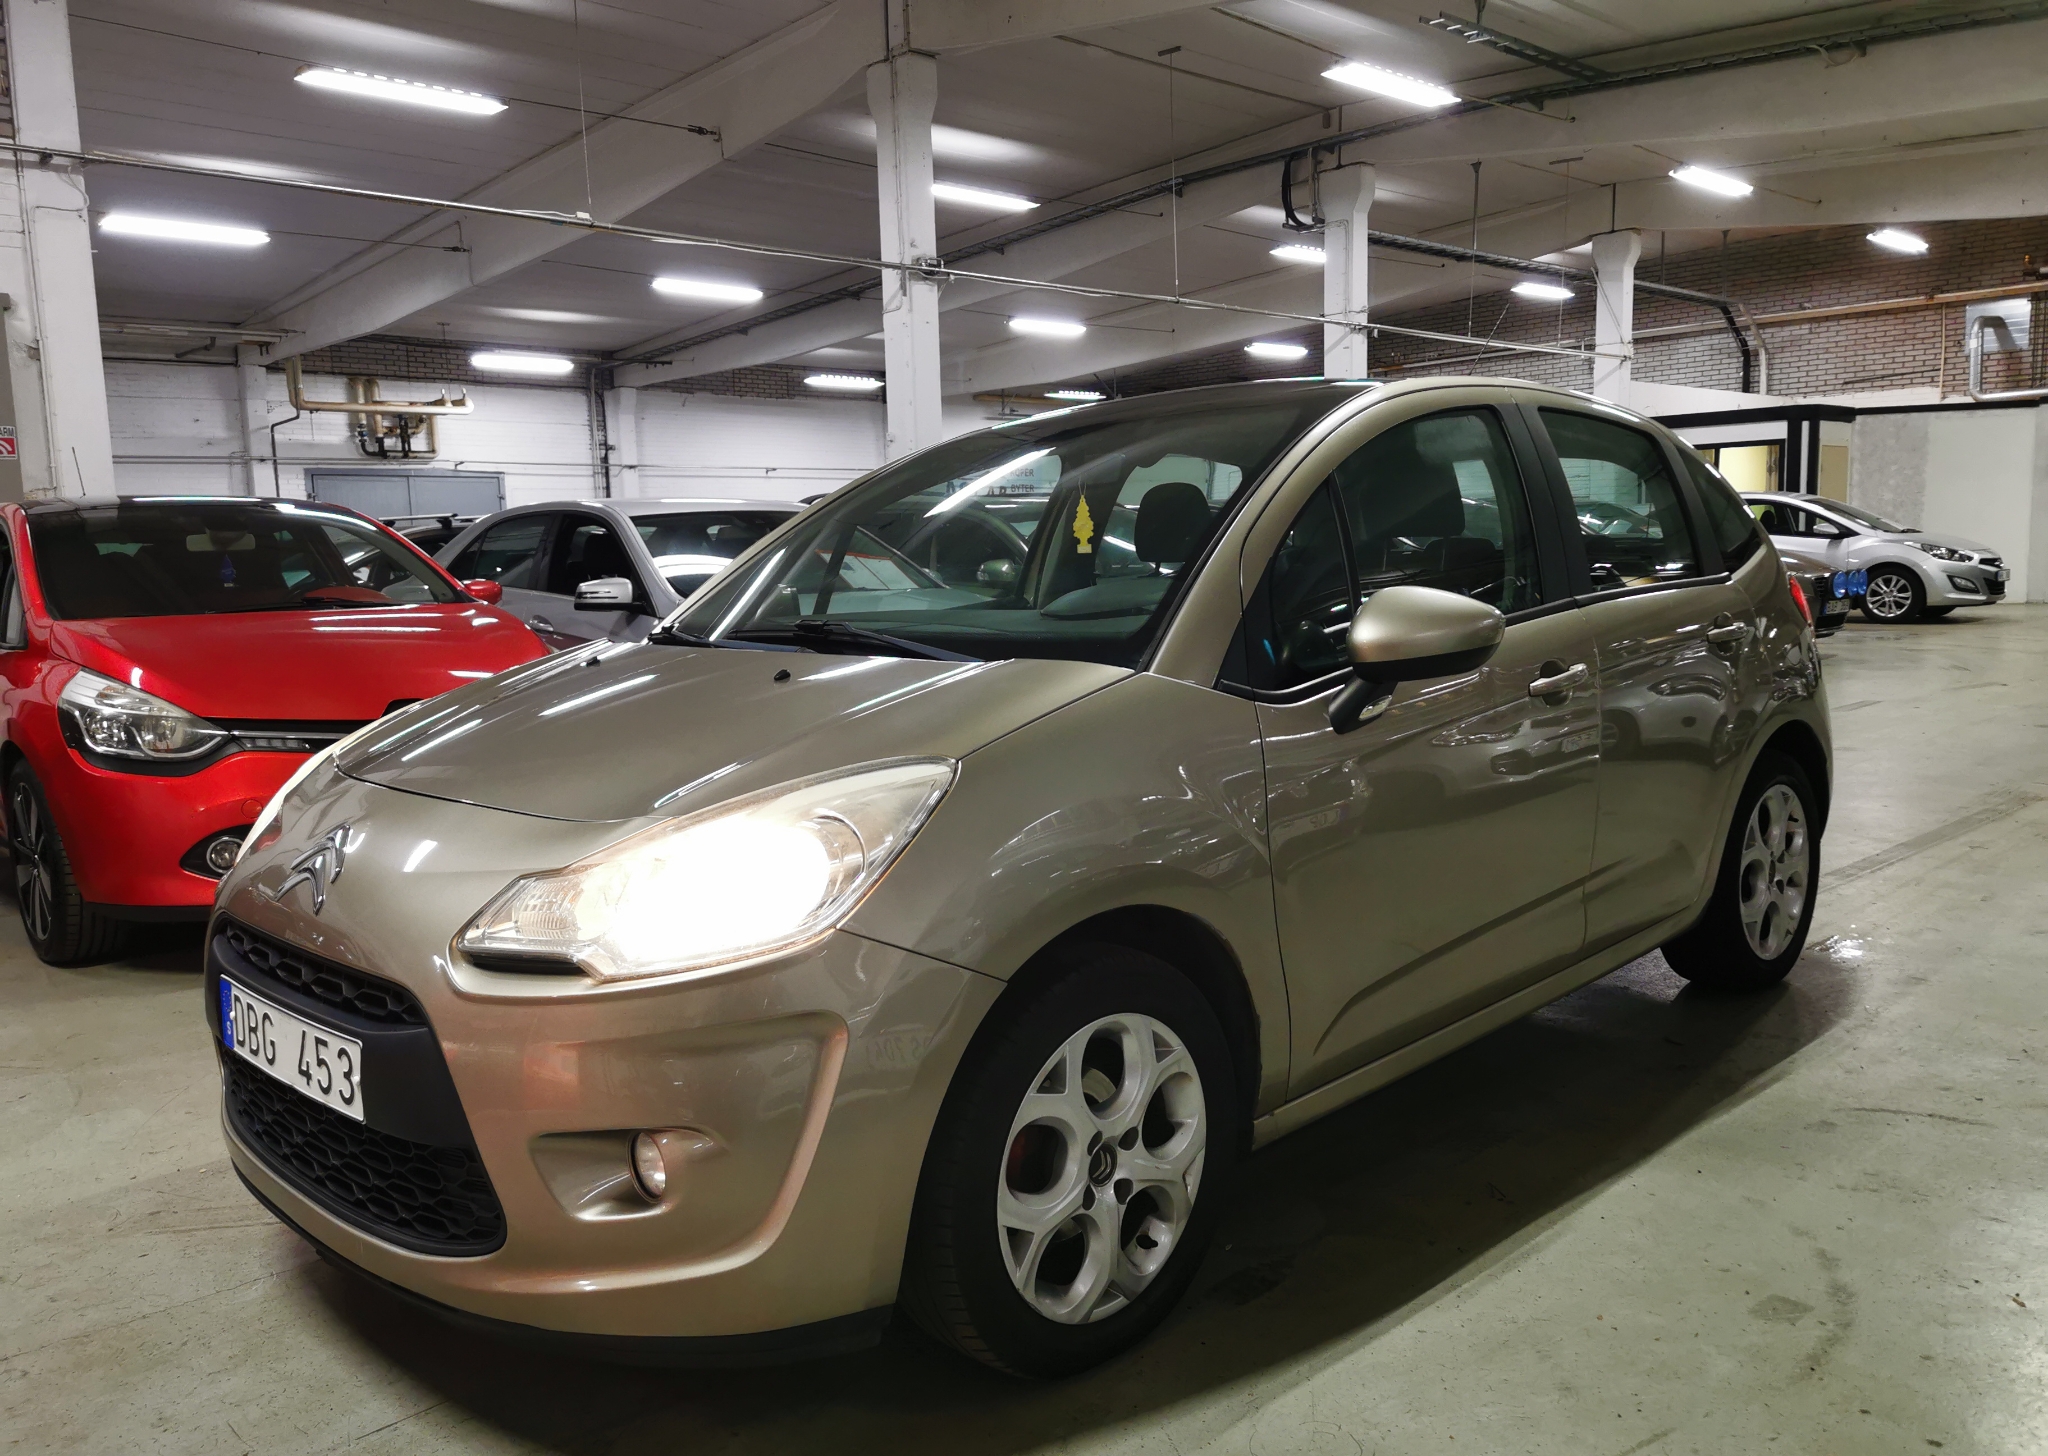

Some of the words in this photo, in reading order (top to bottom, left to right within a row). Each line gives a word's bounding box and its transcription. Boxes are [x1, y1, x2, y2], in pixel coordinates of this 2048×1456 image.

[1010, 483, 1035, 492] BYTER
[233, 992, 277, 1066] DBG
[297, 1029, 356, 1106] 453
